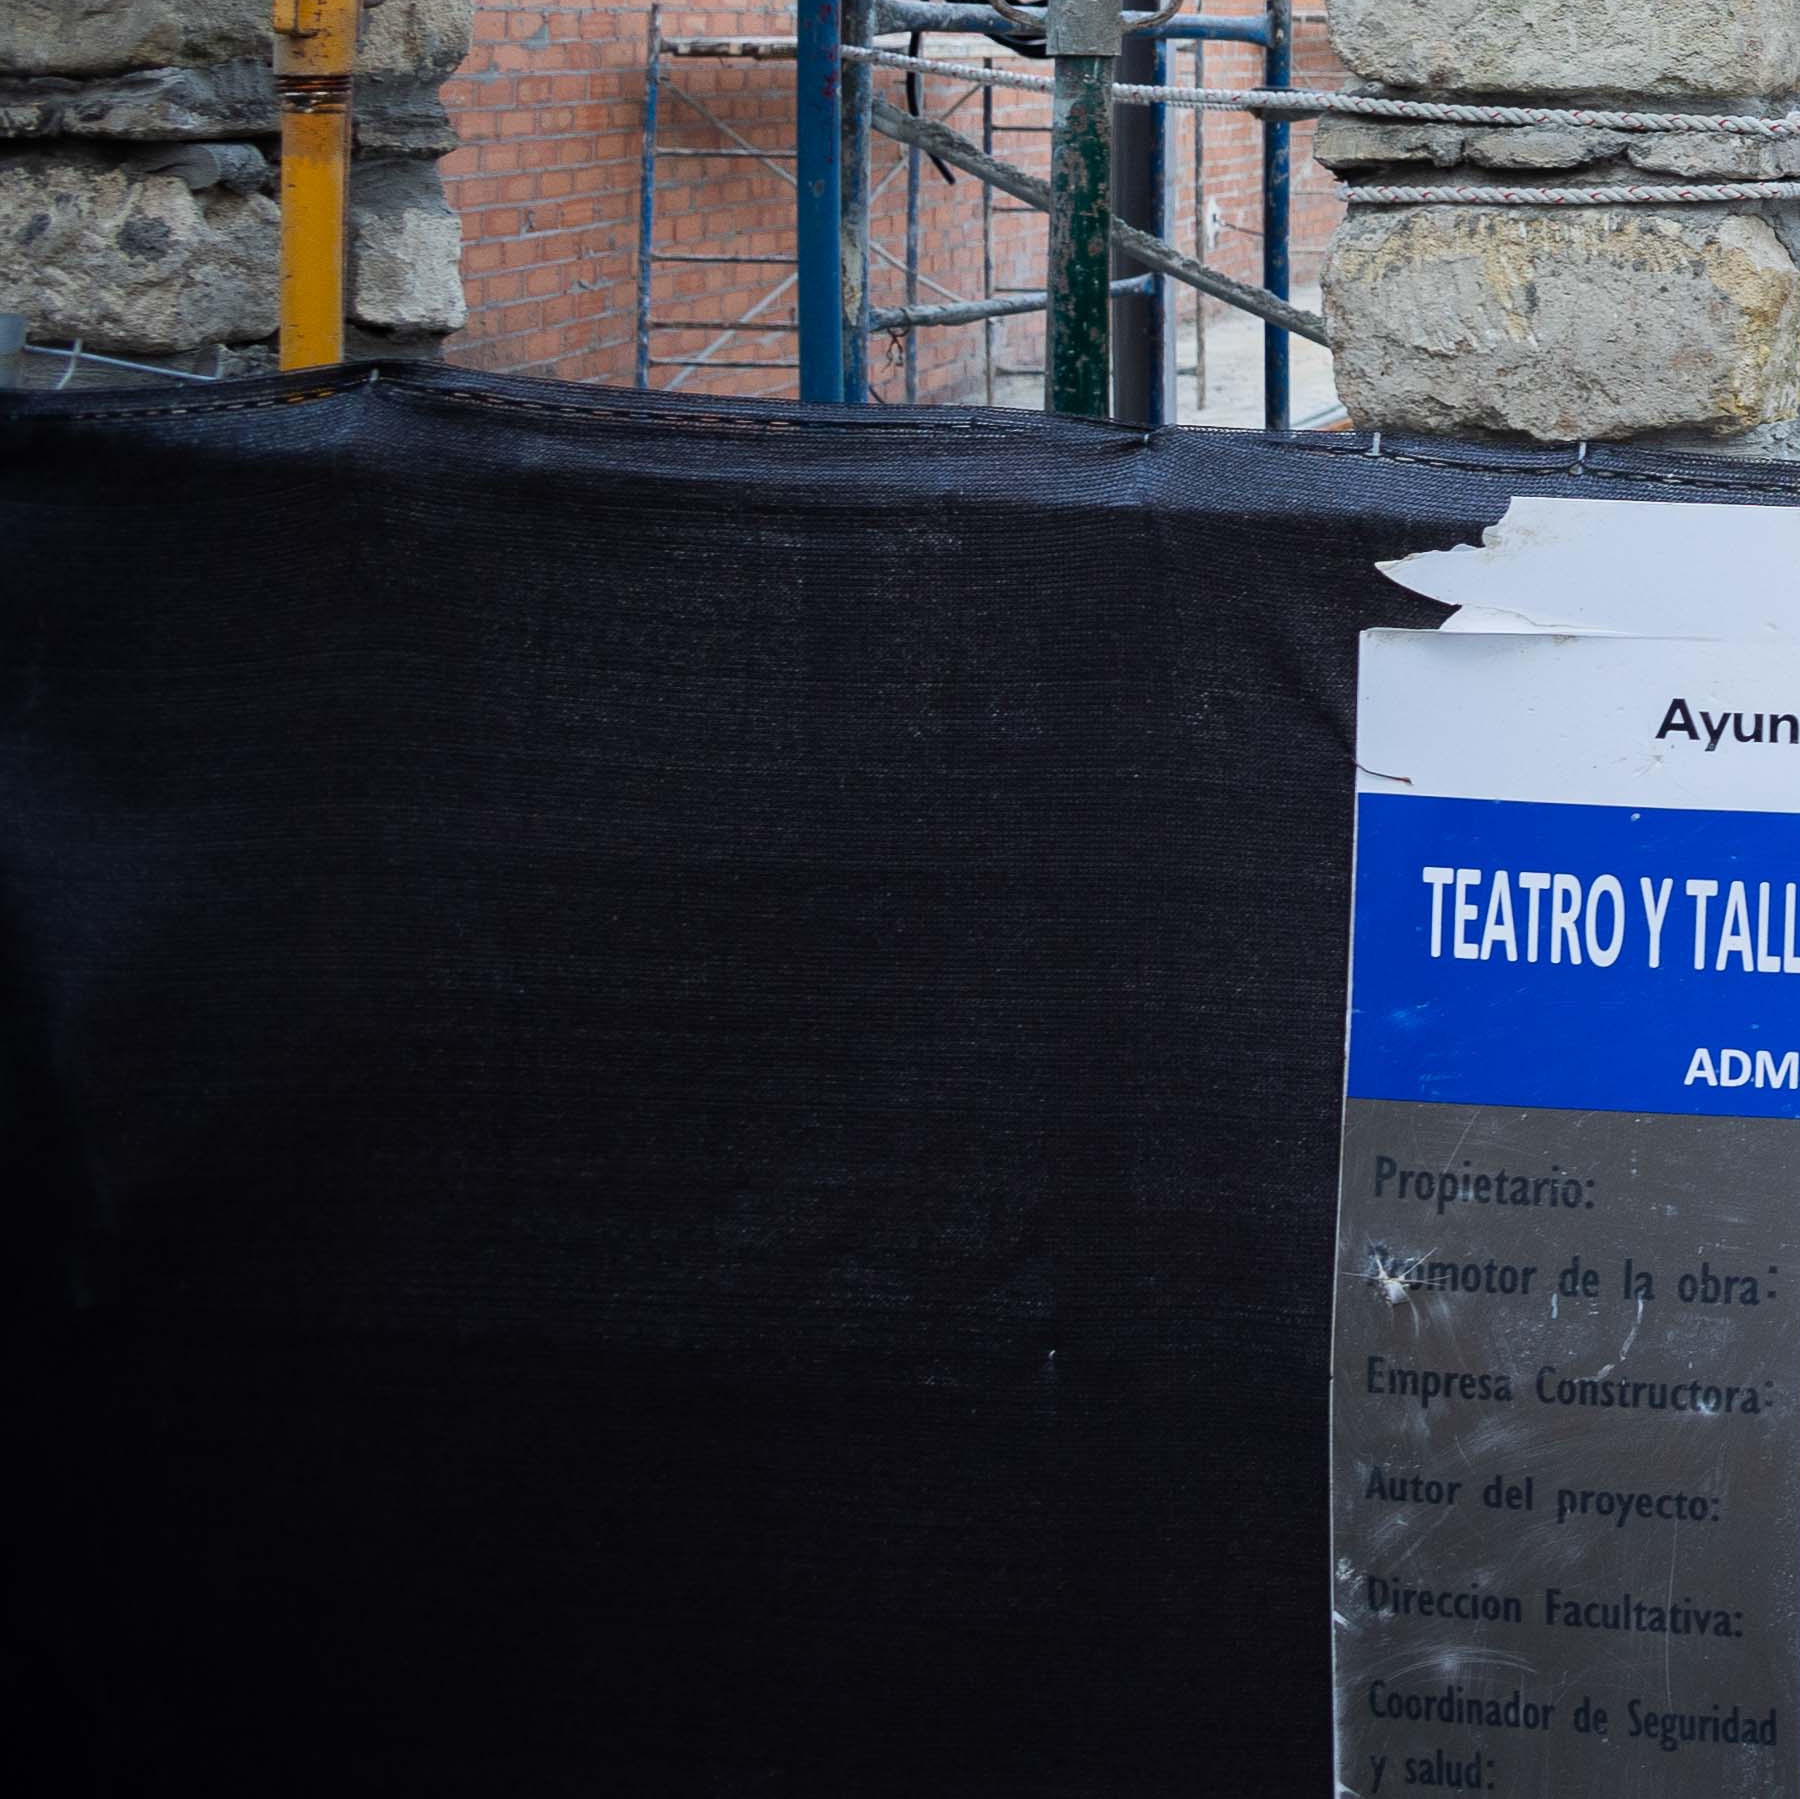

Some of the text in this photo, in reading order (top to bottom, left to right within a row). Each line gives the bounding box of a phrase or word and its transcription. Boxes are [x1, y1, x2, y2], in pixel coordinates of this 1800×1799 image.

[1422, 866, 1626, 968] TEATRO
[1640, 877, 1674, 969] Y
[1375, 1155, 1597, 1214] Propietario:
[1558, 1255, 1600, 1299] de
[1623, 1257, 1655, 1301] la
[1677, 1262, 1778, 1306] obra:
[1367, 1355, 1775, 1415] Empresa Constructora:
[1365, 1467, 1720, 1528] Autor del proyecto:
[1366, 1575, 1744, 1638] Direccion Facultativa:
[1368, 1680, 1778, 1753] Coordinador de Seguridad
[1369, 1749, 1496, 1794] y salud:
